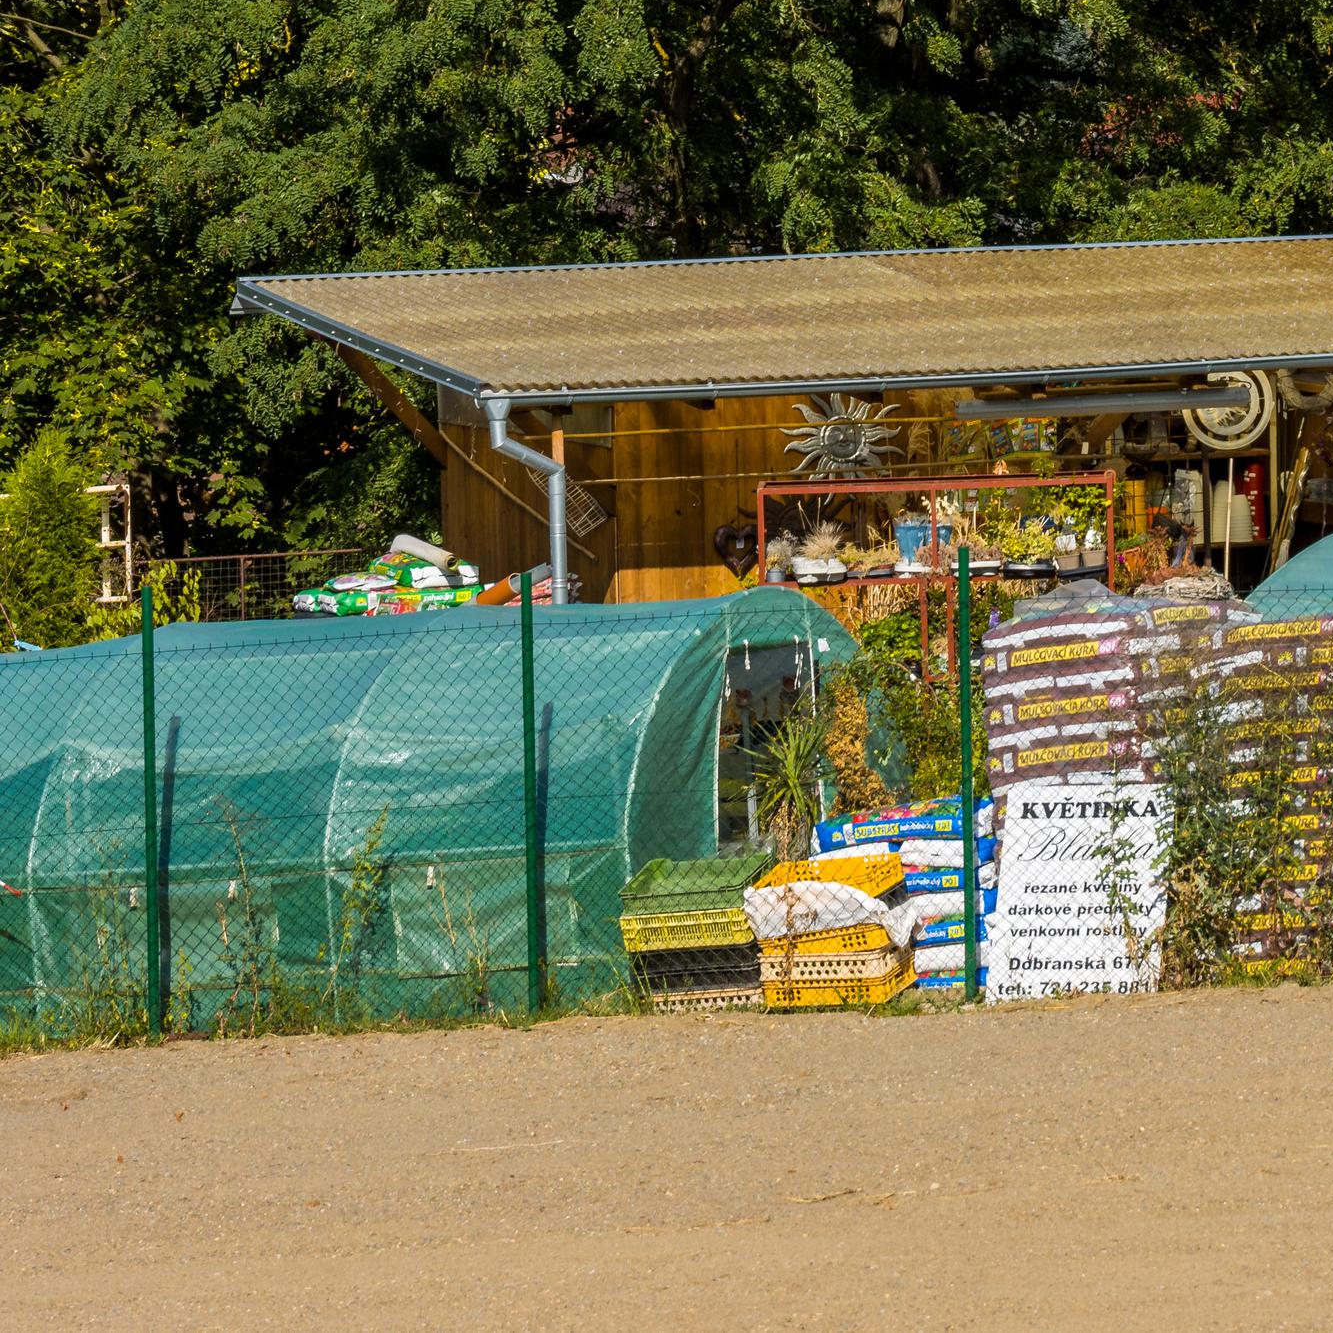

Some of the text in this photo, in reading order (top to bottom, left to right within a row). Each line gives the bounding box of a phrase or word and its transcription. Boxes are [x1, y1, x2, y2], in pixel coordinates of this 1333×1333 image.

[1020, 797, 1159, 819] KVĚTINKA
[1024, 881, 1142, 895] řezané kvěiny
[1008, 904, 1072, 916] dárkové
[1010, 925, 1147, 938] venkovní rostlny
[1009, 956, 1145, 971] Dobřanská 677
